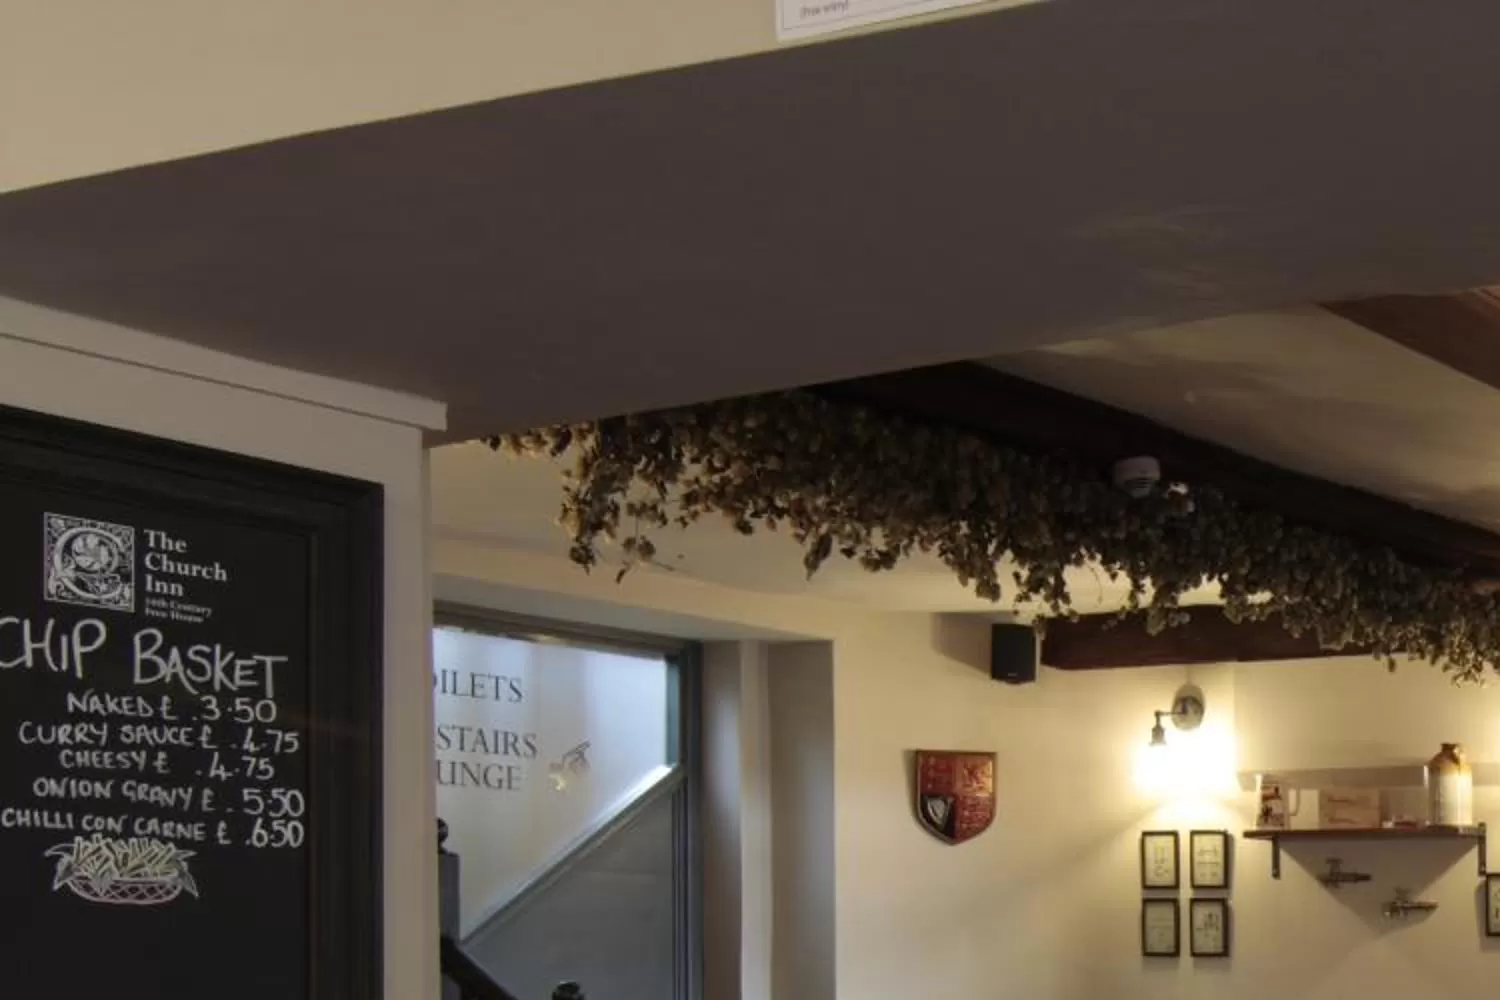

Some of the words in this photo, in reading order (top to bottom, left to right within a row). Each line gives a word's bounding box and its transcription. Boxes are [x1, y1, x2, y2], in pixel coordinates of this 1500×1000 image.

[144, 529, 187, 553] The
[144, 552, 228, 582] Church
[145, 574, 184, 597] Inn
[133, 628, 289, 698] BASKET
[433, 669, 524, 703] ILETS
[67, 688, 153, 718] NAKED
[18, 721, 108, 747] CURRY
[120, 724, 194, 746] SAUCE
[59, 749, 147, 772] CHEESY
[32, 776, 115, 799] ONION
[121, 779, 193, 812] GRAVY
[1, 807, 74, 830] CHILLI
[81, 814, 129, 834] CON
[133, 817, 206, 841] CARNE
